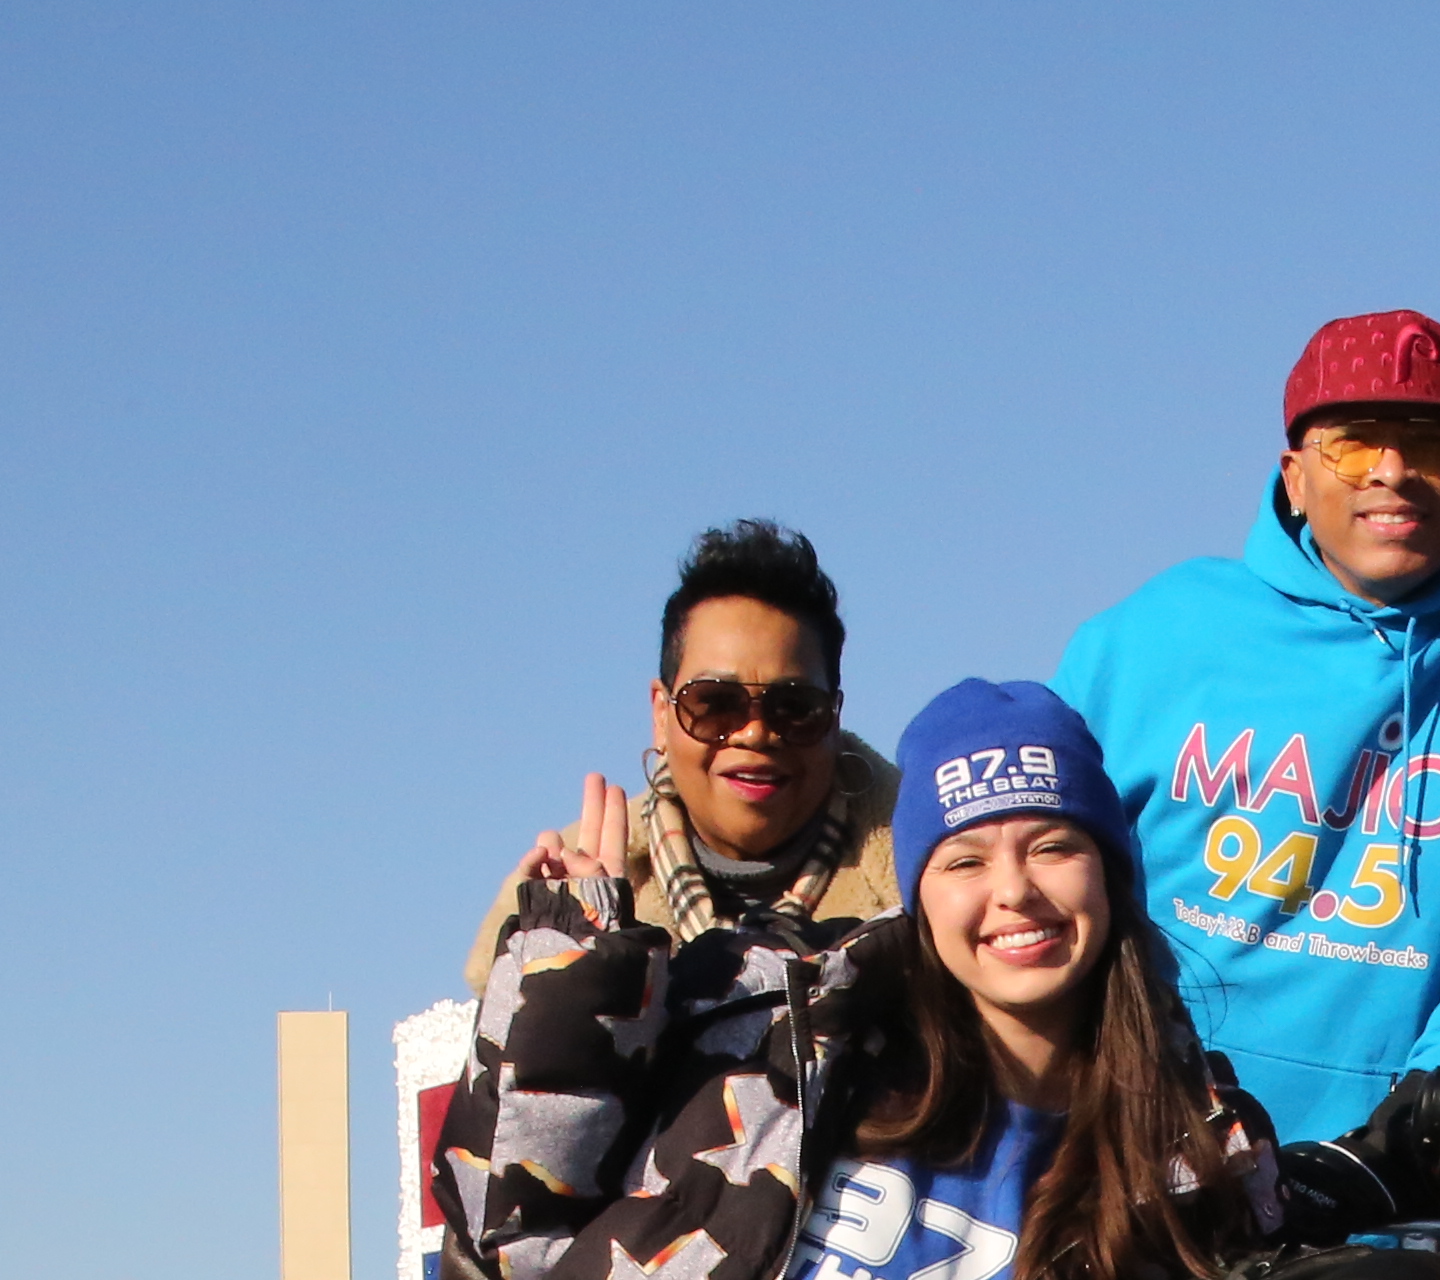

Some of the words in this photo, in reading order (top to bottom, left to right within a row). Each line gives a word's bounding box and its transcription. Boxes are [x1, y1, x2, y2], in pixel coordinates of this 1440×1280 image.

[935, 744, 1058, 796] 97.9
[939, 781, 990, 808] THE
[992, 774, 1059, 793] BEAT
[1204, 815, 1410, 928] 94.5
[1263, 930, 1305, 953] and
[1309, 933, 1430, 970] Throwbacks
